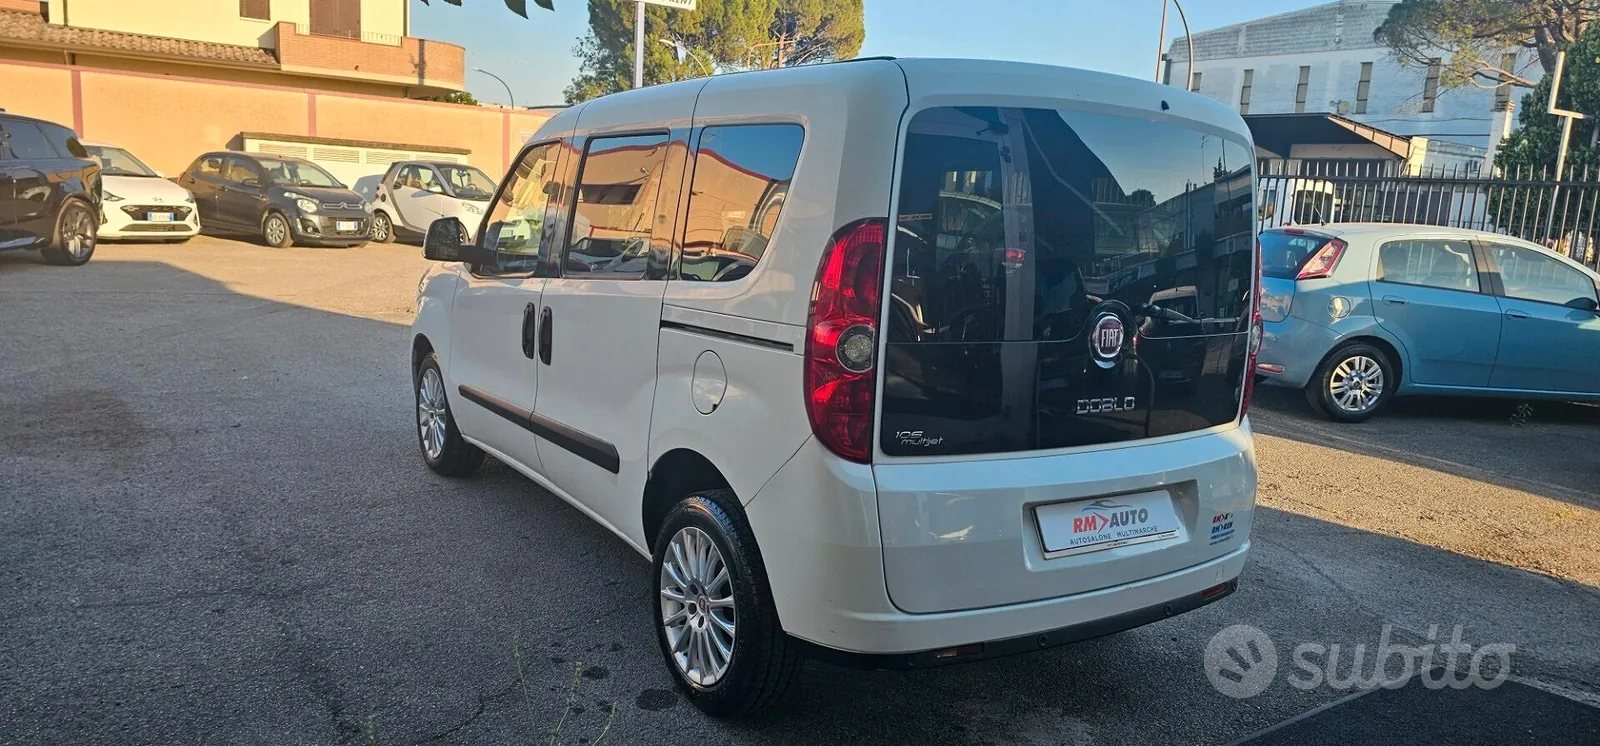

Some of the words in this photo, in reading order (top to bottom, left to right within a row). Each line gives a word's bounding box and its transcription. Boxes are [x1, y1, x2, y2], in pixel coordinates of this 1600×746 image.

[1100, 328, 1119, 348] FIAT
[1076, 396, 1136, 415] DOBLO
[900, 436, 944, 447] multijet
[1069, 533, 1112, 546] AUTOSALONE
[1116, 525, 1159, 537] MULTIMARCHE
